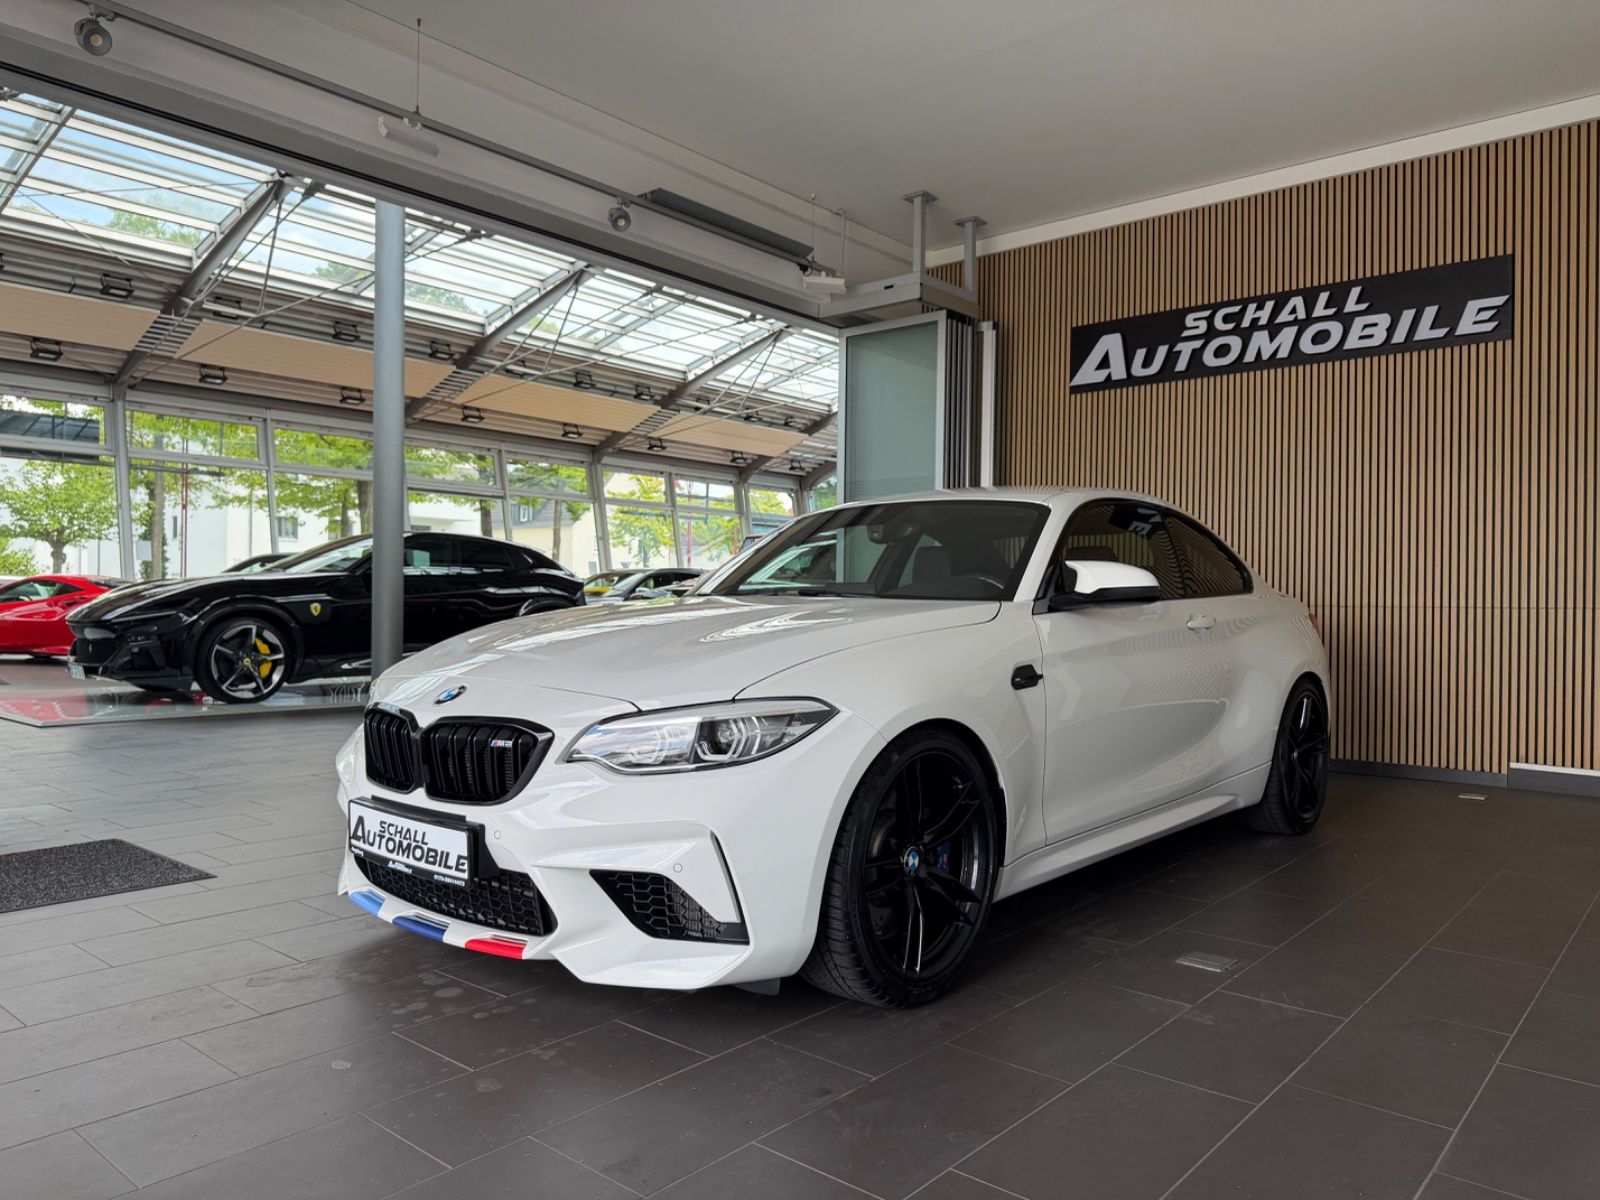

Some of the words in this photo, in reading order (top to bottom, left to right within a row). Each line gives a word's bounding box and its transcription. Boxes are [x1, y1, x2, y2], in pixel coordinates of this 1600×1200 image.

[1181, 286, 1371, 337] SCHALL
[1069, 295, 1511, 387] AUTOMOBILE
[351, 815, 469, 874] AUTOMOBILE
[379, 820, 429, 846] SCHALL
